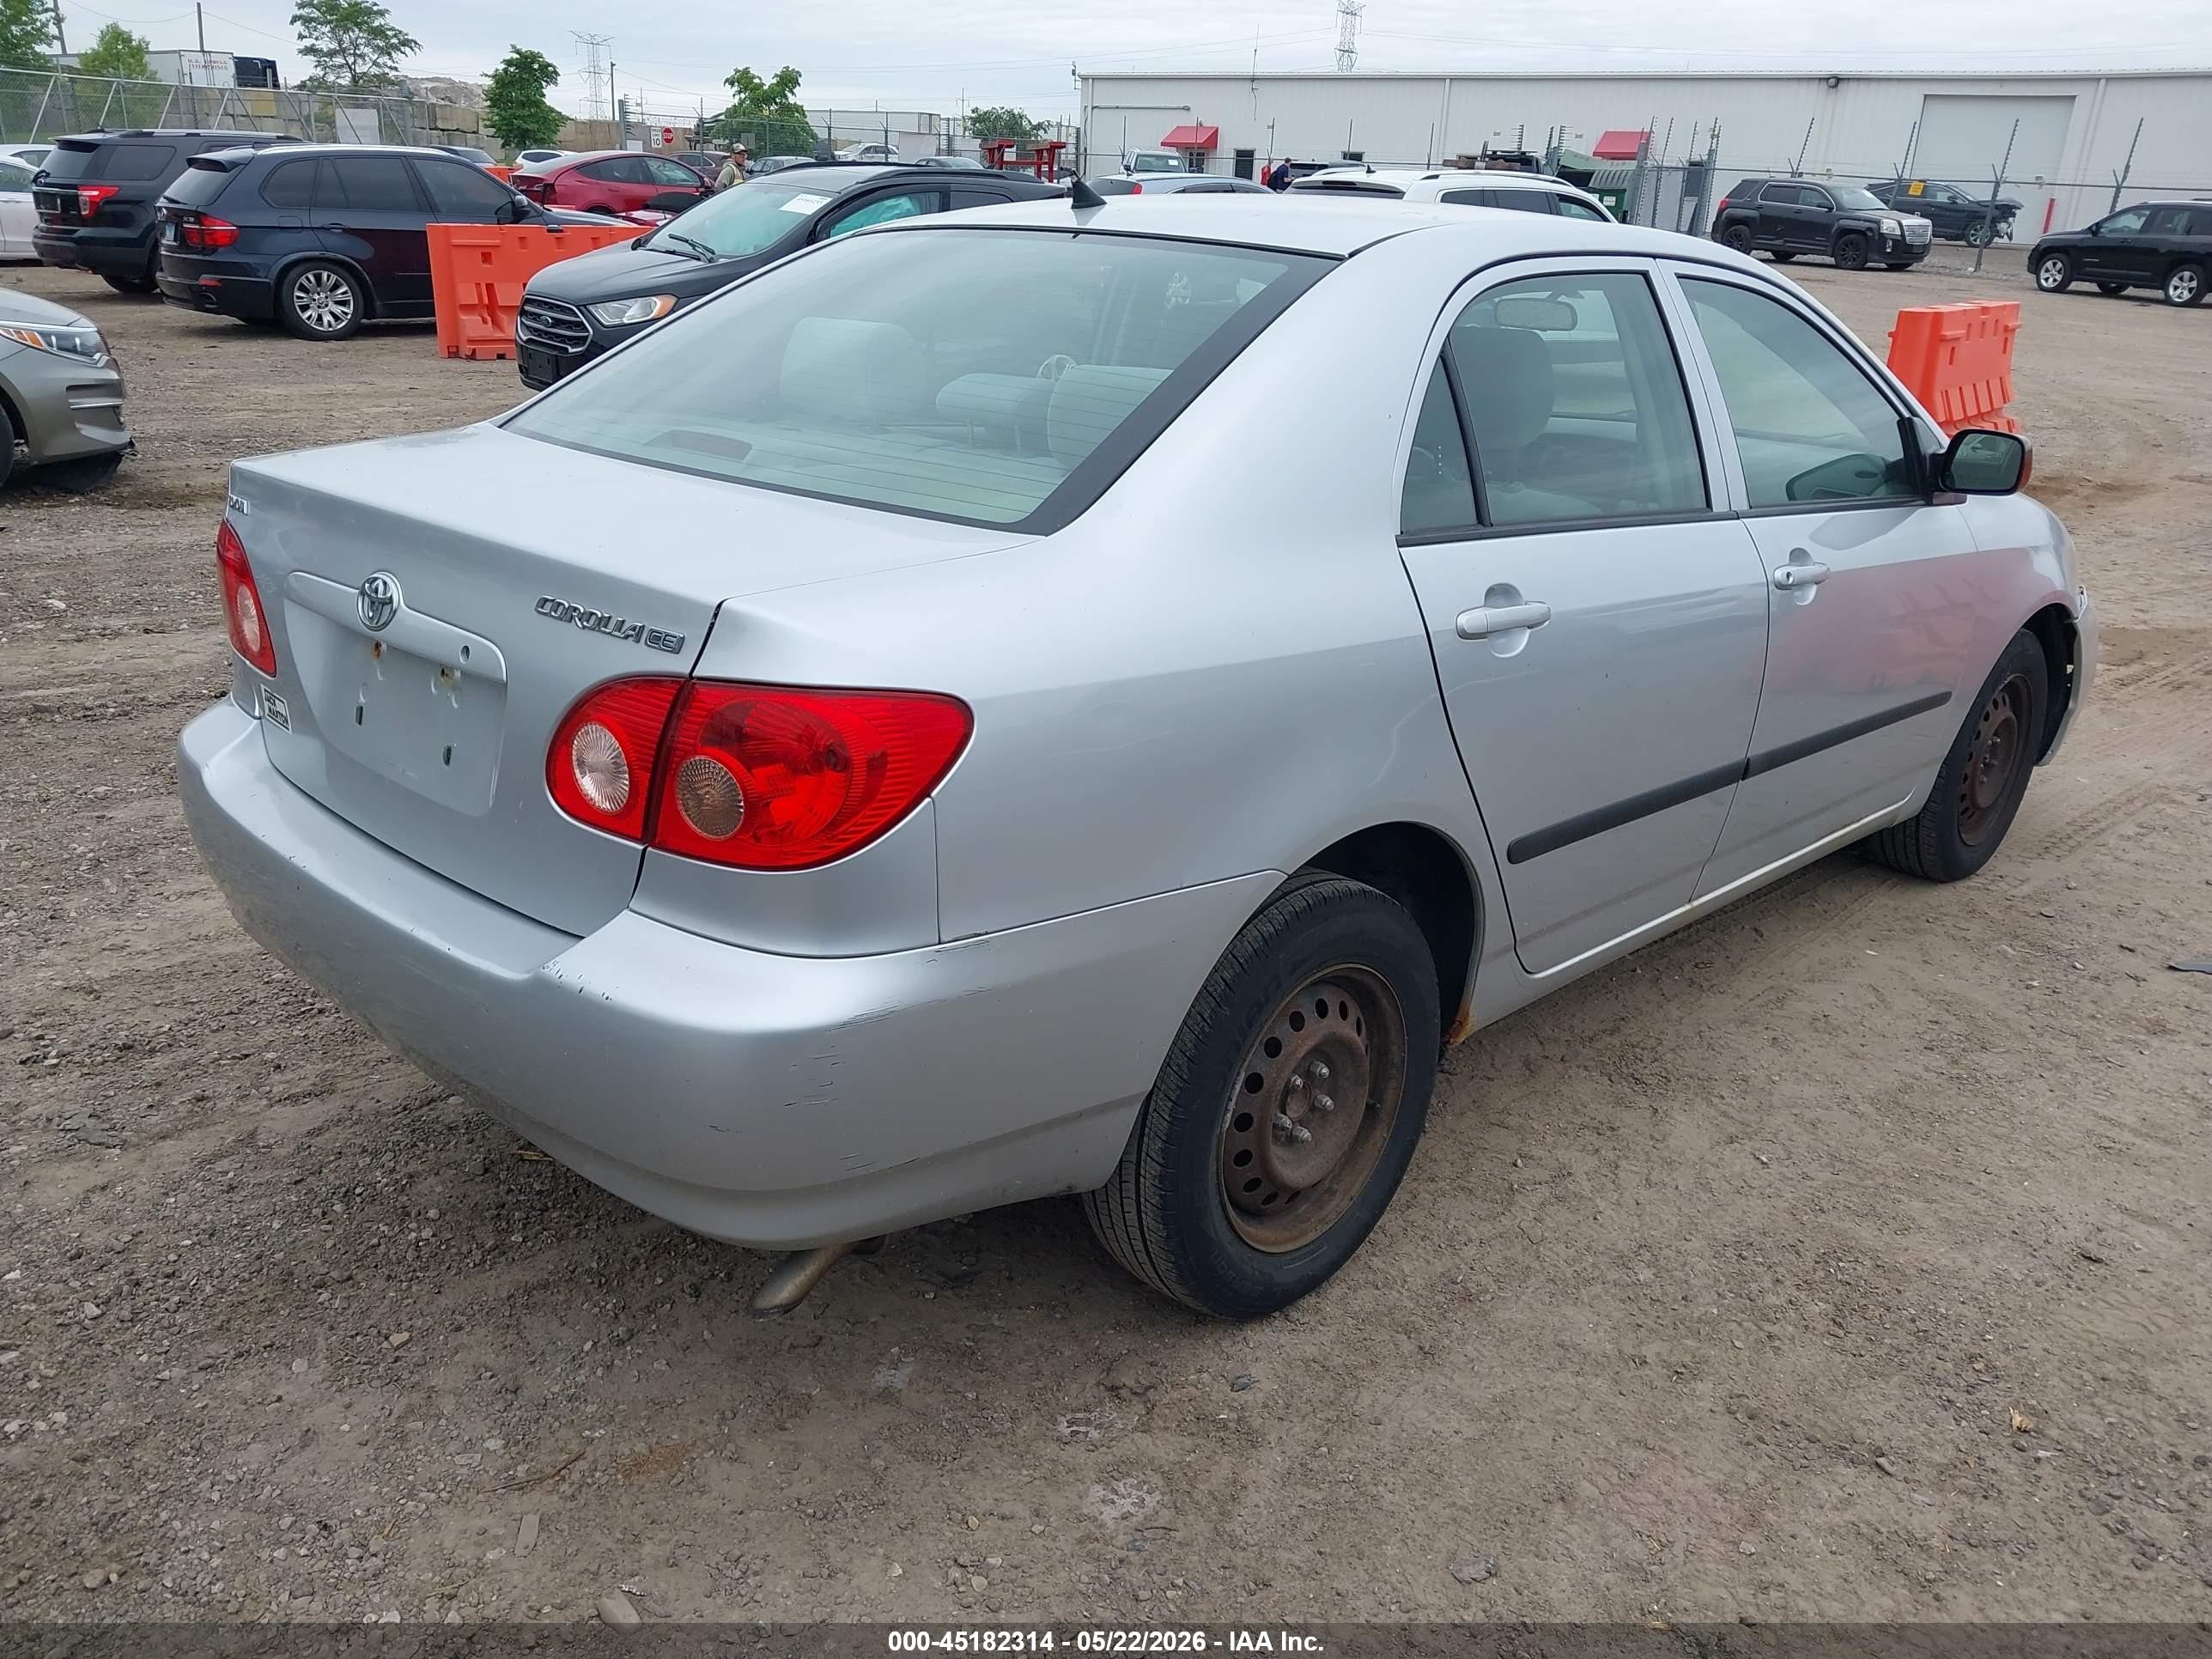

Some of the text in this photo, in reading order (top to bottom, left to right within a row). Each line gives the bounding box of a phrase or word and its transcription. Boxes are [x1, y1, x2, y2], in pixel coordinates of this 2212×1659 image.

[653, 137, 661, 146] 10
[534, 594, 686, 655] COROLLA CE
